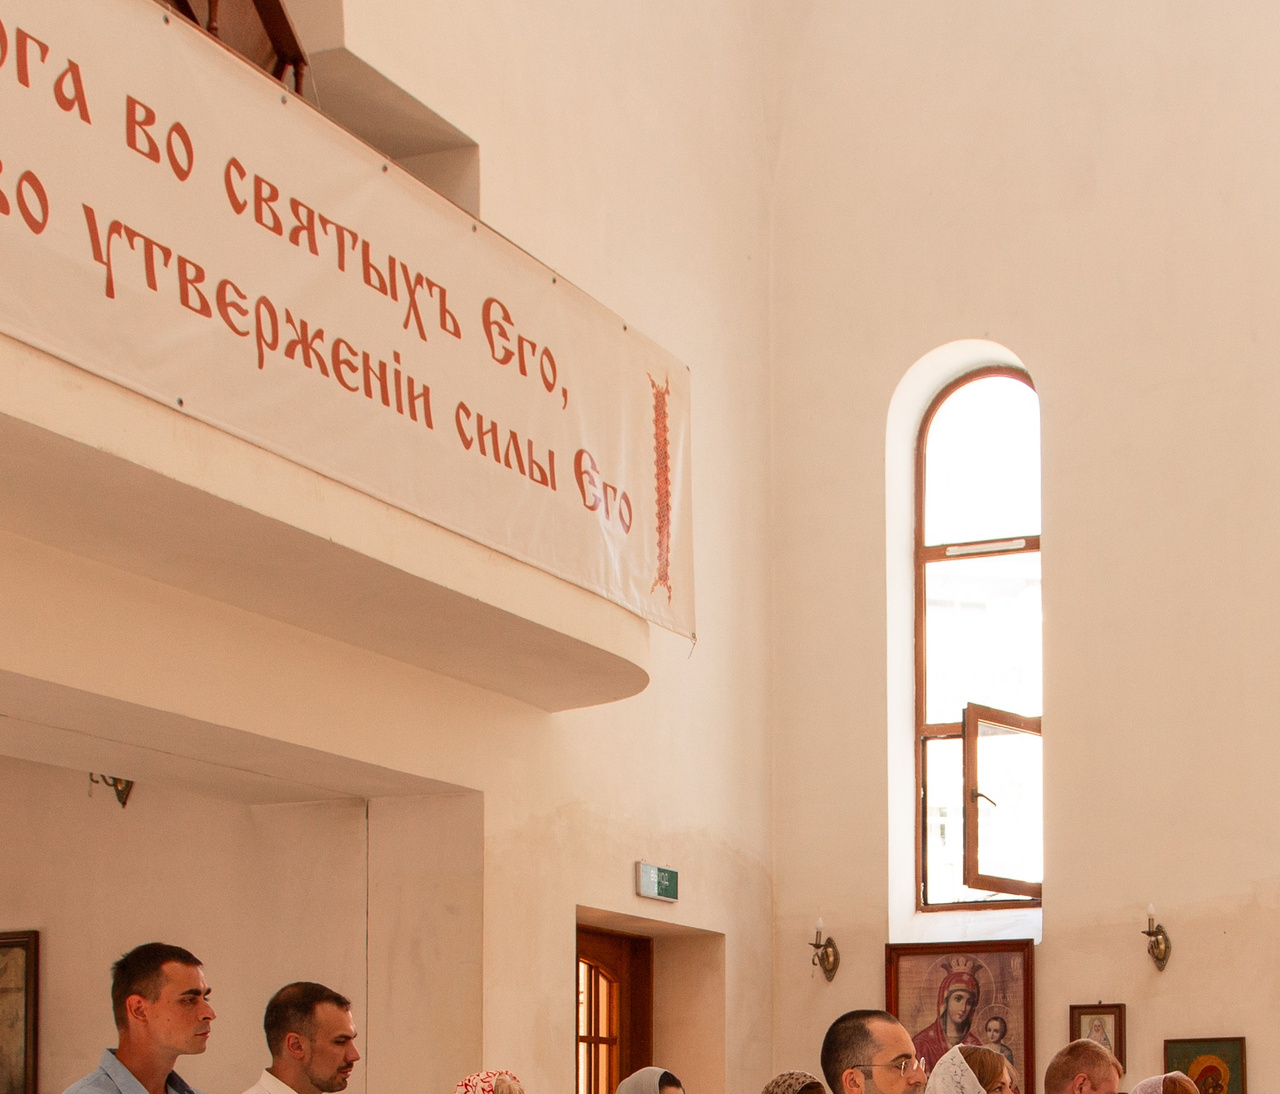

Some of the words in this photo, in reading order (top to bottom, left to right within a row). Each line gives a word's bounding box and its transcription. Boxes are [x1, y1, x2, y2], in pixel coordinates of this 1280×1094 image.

[125, 95, 194, 183] во
[224, 157, 462, 342] святыхъ
[455, 401, 557, 491] силы
